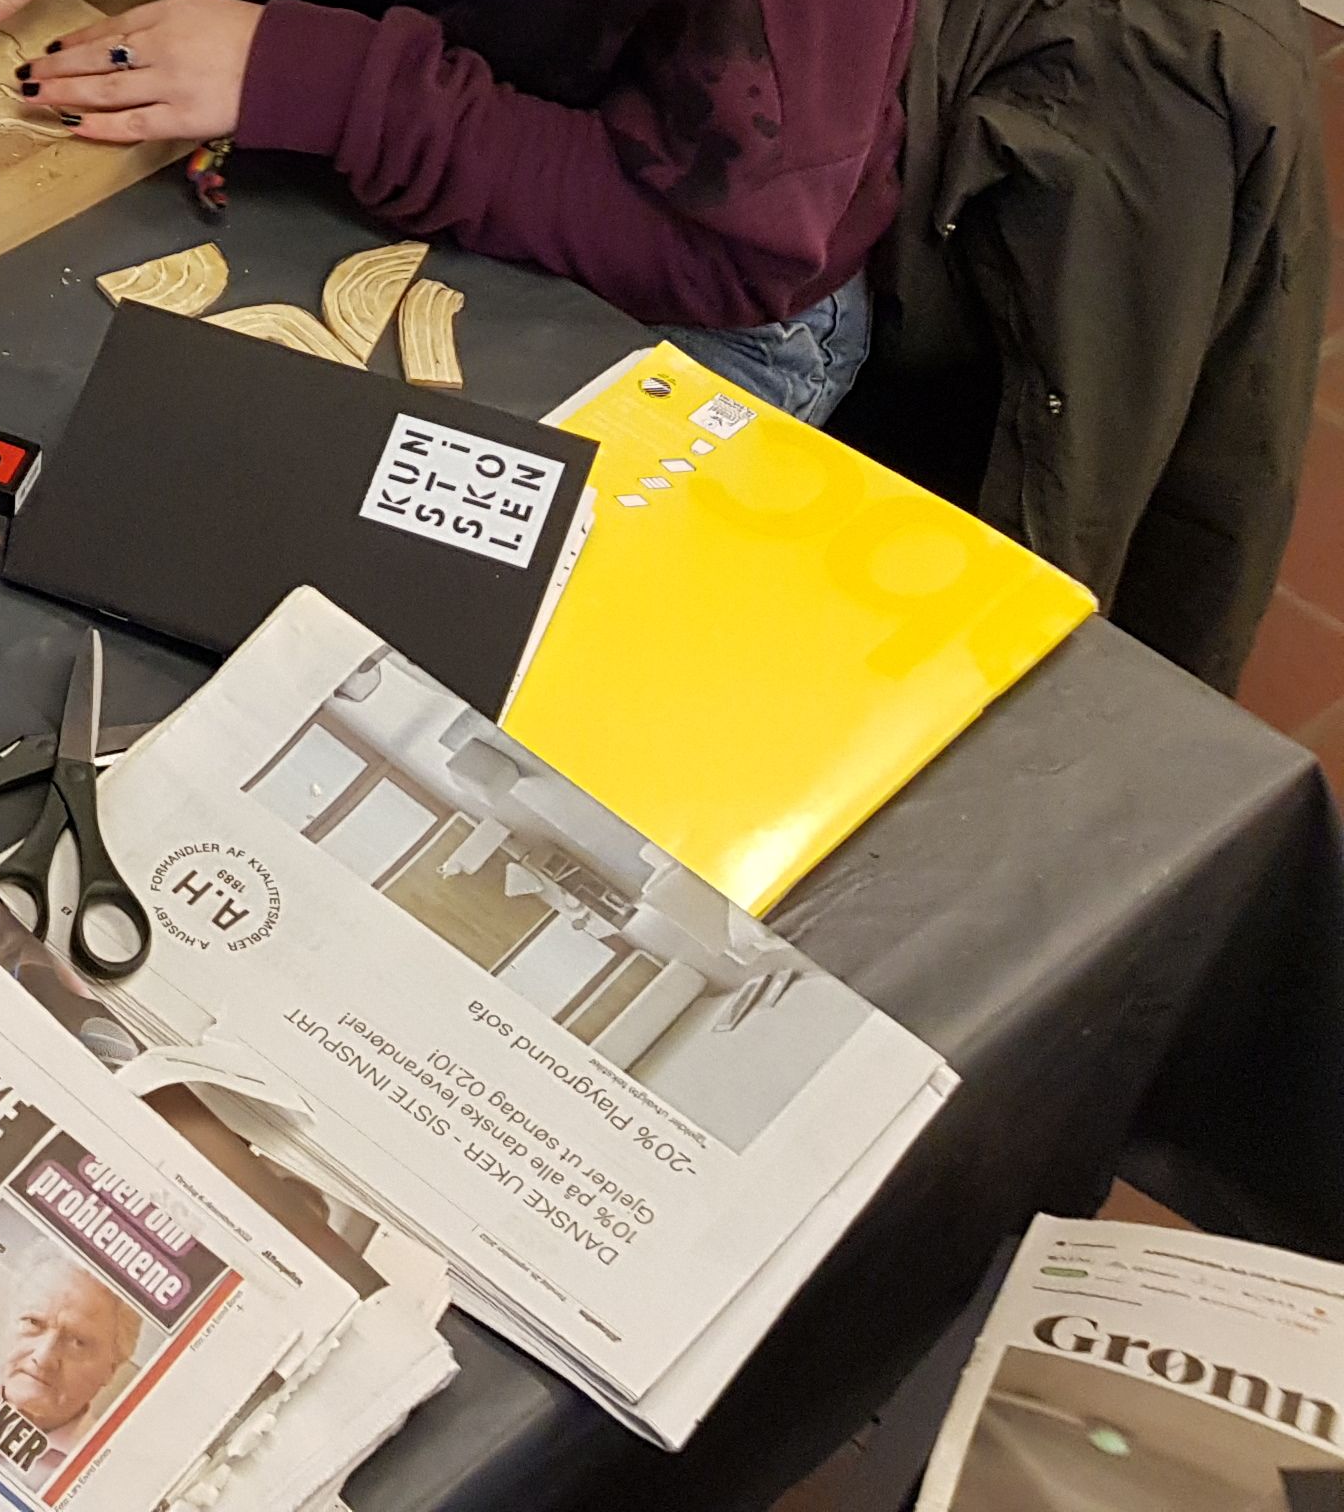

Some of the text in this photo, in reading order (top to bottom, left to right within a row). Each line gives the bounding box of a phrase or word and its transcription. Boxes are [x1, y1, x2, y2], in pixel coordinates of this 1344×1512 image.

[376, 427, 433, 516] KUN
[451, 449, 508, 540] SKO
[488, 461, 545, 551] LEN
[149, 842, 218, 890] FORHANDLER
[225, 846, 243, 856] AF
[171, 869, 249, 930] A.H
[215, 867, 246, 894] 1889
[282, 1002, 393, 1094] INNSPURT
[463, 995, 701, 1182] -20% Playground sofa
[336, 1008, 639, 1247] 10% på alle danske leverandører!
[386, 1081, 453, 1139] SISTE
[425, 1045, 659, 1229] Gjelder ut søndag 02.10!
[461, 1139, 526, 1195] UKER
[28, 1165, 185, 1306] problemene
[522, 1185, 620, 1267] DANSKE
